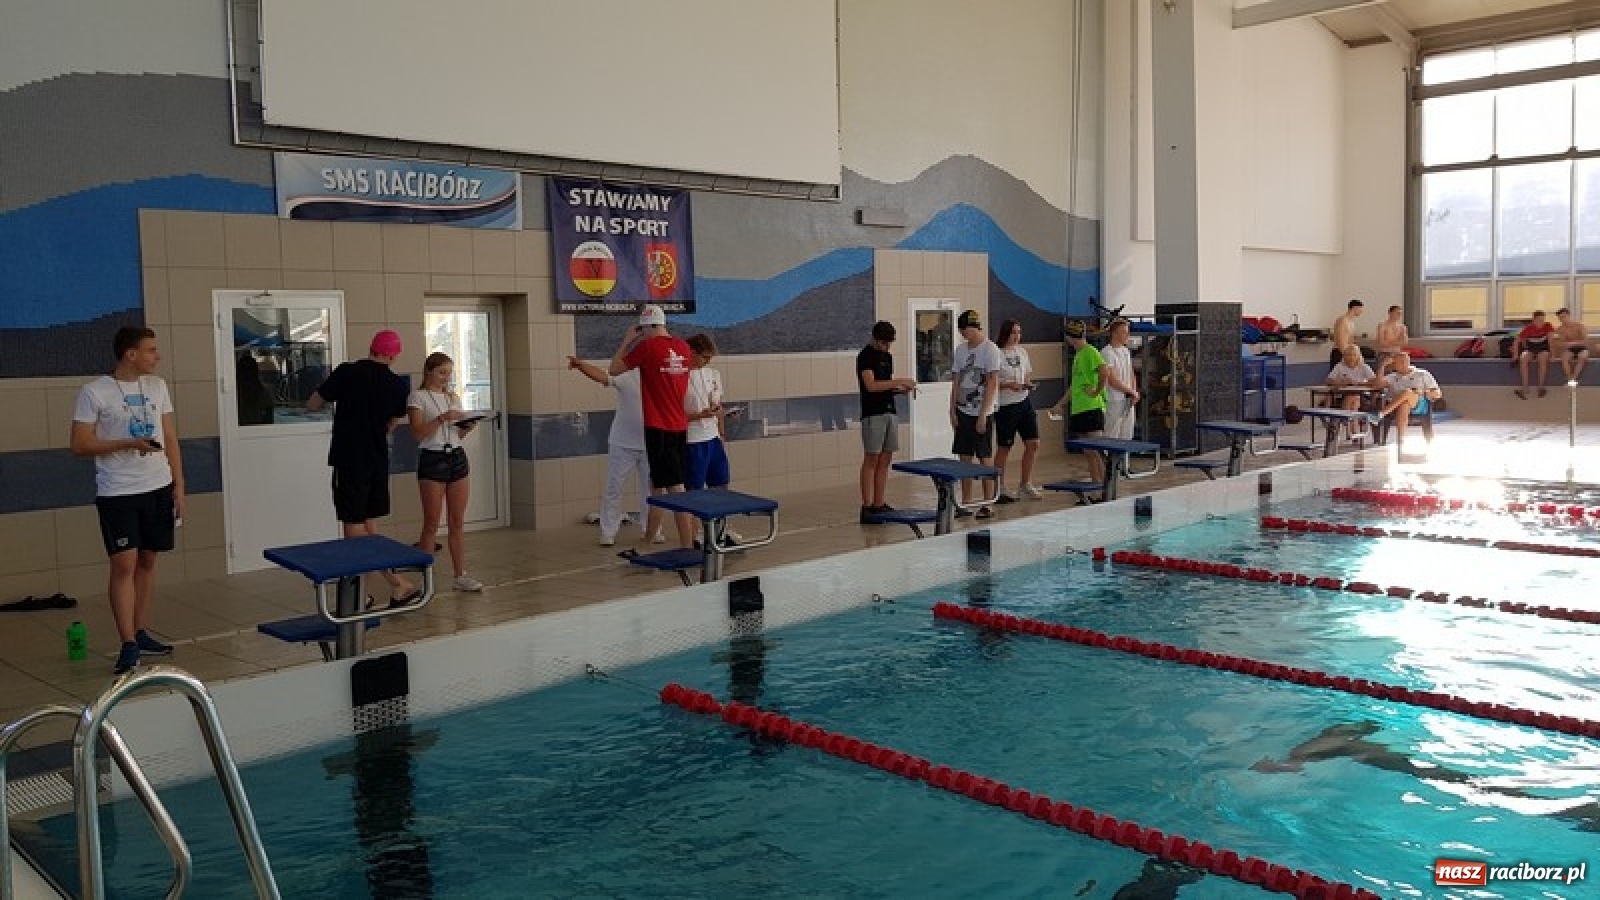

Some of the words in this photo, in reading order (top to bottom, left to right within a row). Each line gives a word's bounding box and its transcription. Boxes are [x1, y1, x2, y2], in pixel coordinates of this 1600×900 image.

[321, 167, 370, 193] SMS
[375, 169, 483, 199] RACIBÓRZ
[569, 187, 673, 212] STAWIAMY
[575, 215, 607, 233] NA
[609, 217, 669, 237] SPORT
